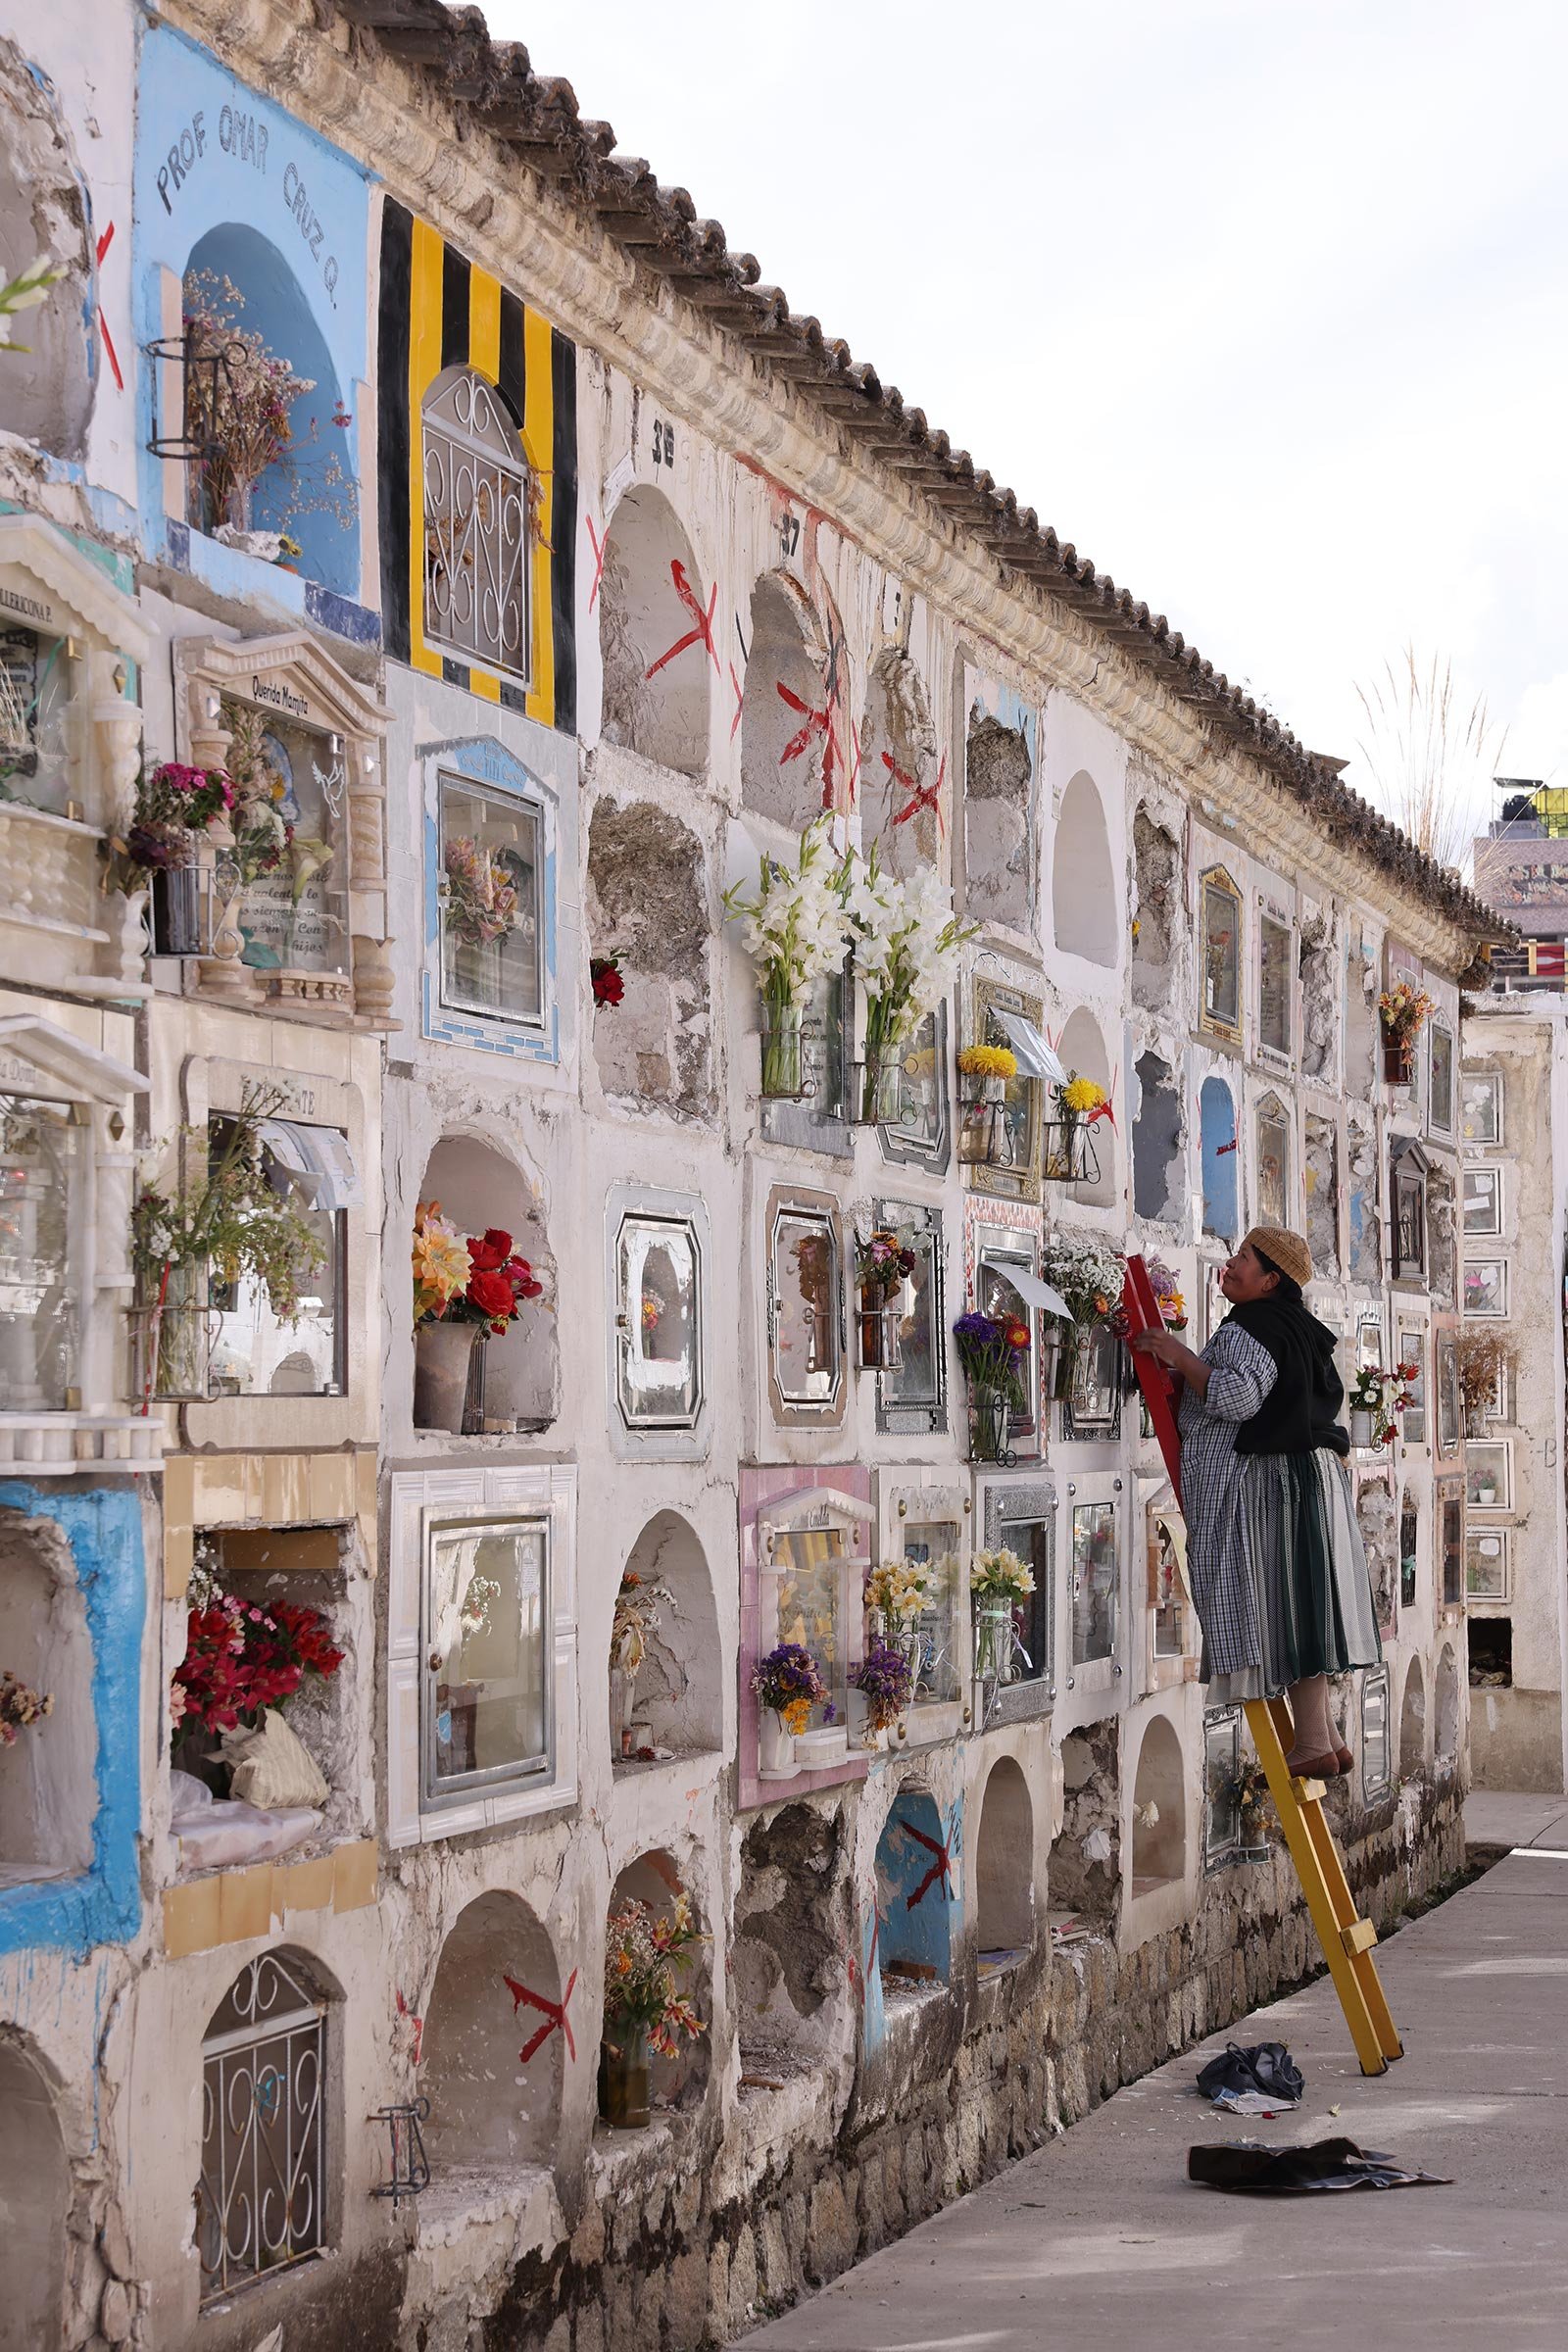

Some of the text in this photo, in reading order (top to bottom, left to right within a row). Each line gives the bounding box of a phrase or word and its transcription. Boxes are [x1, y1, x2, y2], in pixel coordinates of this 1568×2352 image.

[220, 105, 269, 174] OMAR
[283, 163, 324, 263] CRUZ
[253, 675, 308, 716] Querida Mamita
[297, 922, 321, 935] Con
